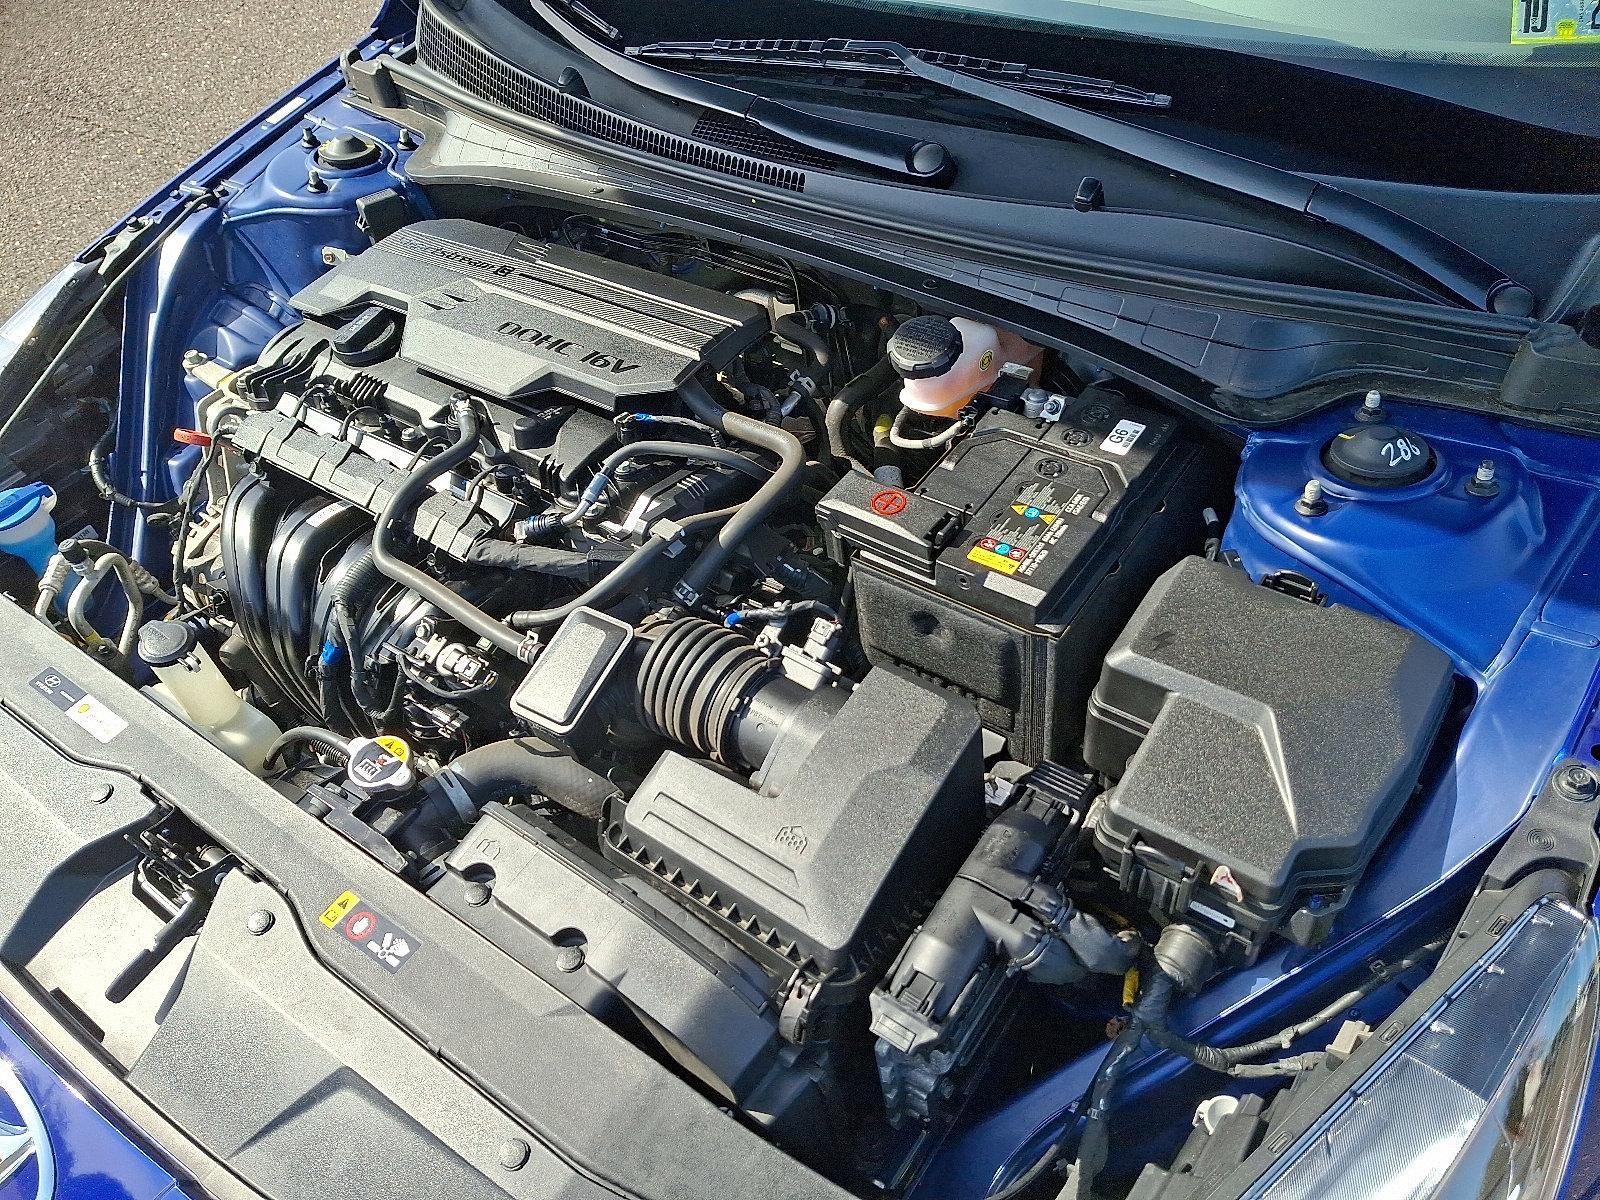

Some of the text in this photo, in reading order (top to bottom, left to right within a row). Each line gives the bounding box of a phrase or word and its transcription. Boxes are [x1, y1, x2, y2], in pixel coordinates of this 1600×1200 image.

[497, 321, 641, 374] DOHC 16V
[1109, 428, 1129, 443] G6
[1381, 437, 1420, 467] 286
